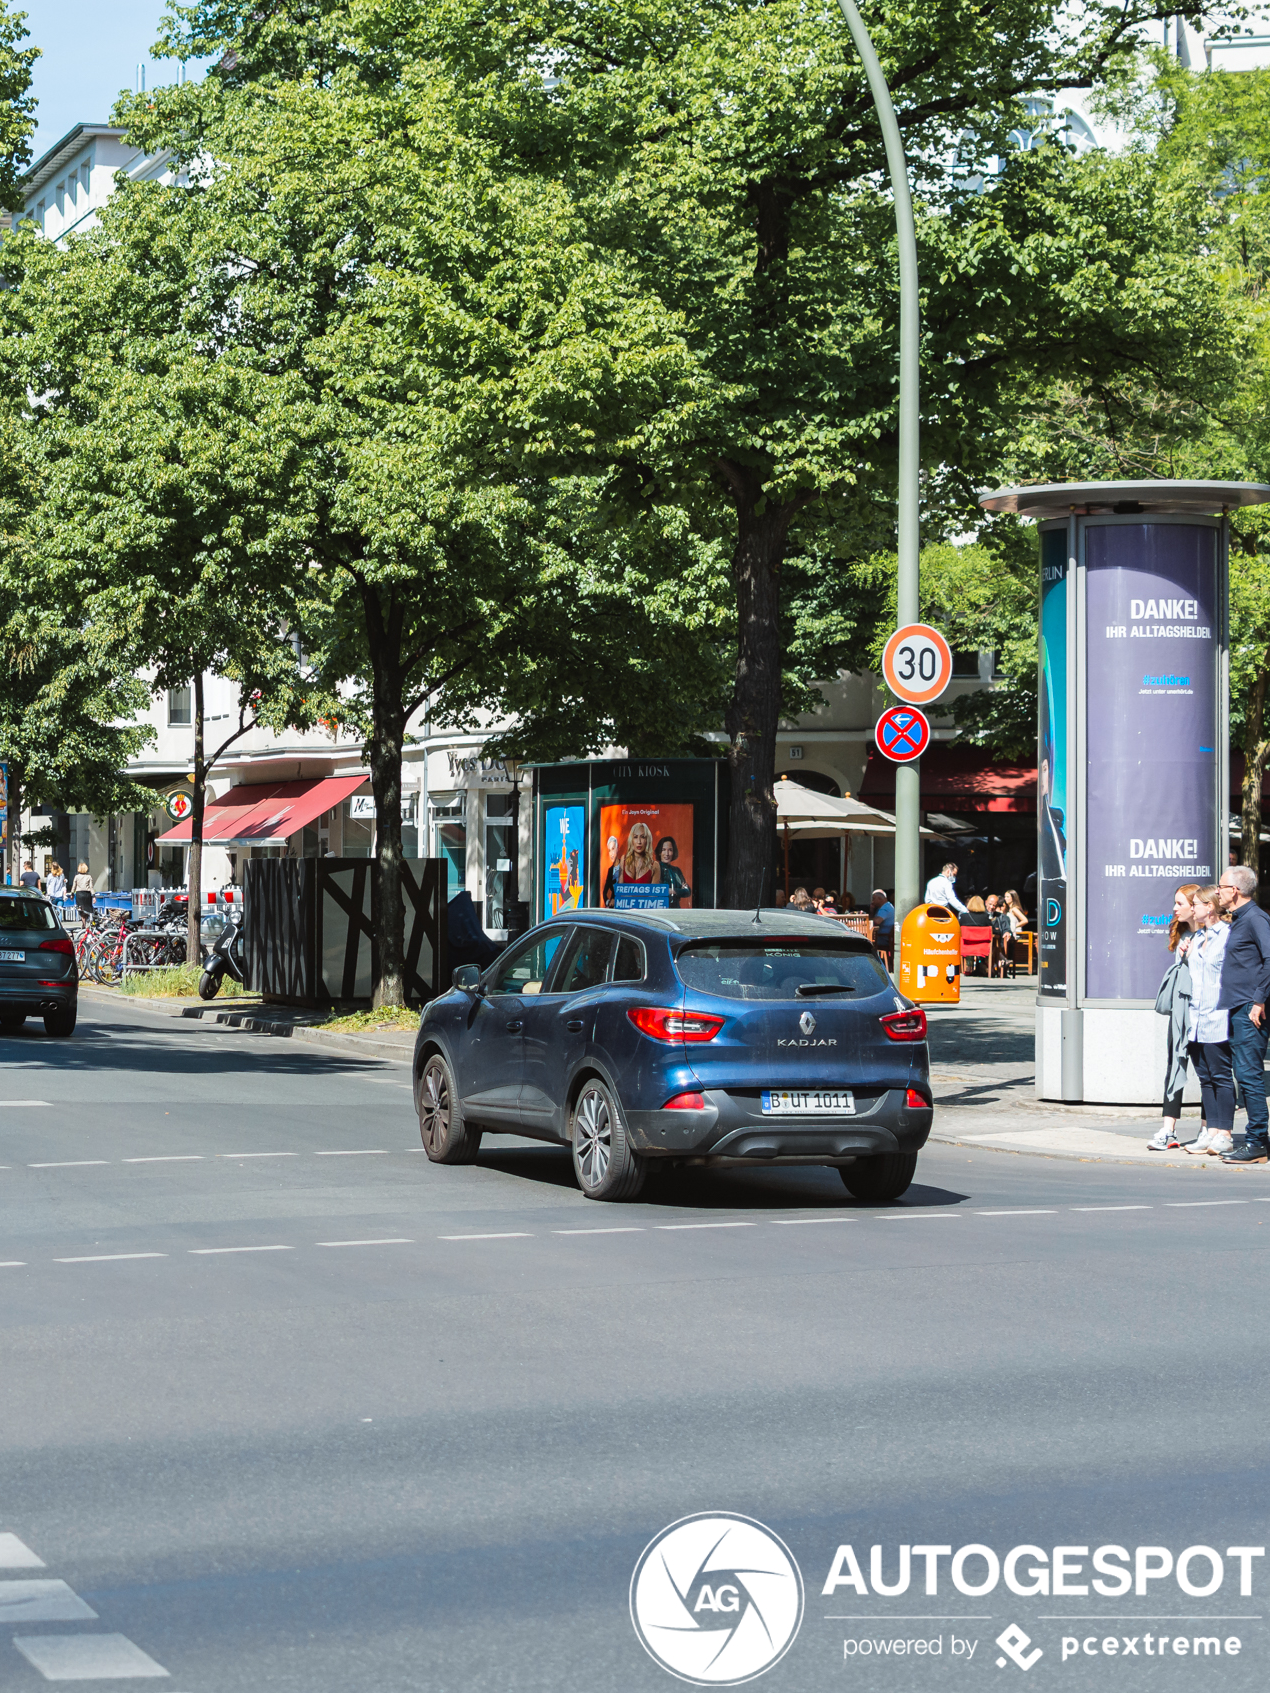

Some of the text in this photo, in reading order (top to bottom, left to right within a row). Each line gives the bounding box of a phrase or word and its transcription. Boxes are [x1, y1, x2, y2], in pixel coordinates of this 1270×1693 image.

[1130, 599, 1198, 620] DANKE!
[1106, 626, 1212, 639] IHR ALLTAGSHELDEN.
[898, 646, 936, 681] 30
[1143, 674, 1190, 686] #zuhören
[791, 749, 800, 757] 51
[638, 765, 670, 777] KIOSK
[640, 809, 659, 817] Original
[559, 818, 570, 834] WE
[1129, 838, 1198, 859] DANKE!
[1105, 865, 1212, 877] IHR ALLTAGSHELDEN.
[616, 884, 667, 894] FREITAGS IST
[616, 899, 667, 909] MILF TIME.
[1141, 914, 1173, 925] #zuhö
[777, 1039, 838, 1047] KADJAR
[770, 1093, 781, 1108] B
[791, 1093, 810, 1108] UT
[814, 1093, 851, 1108] 1011
